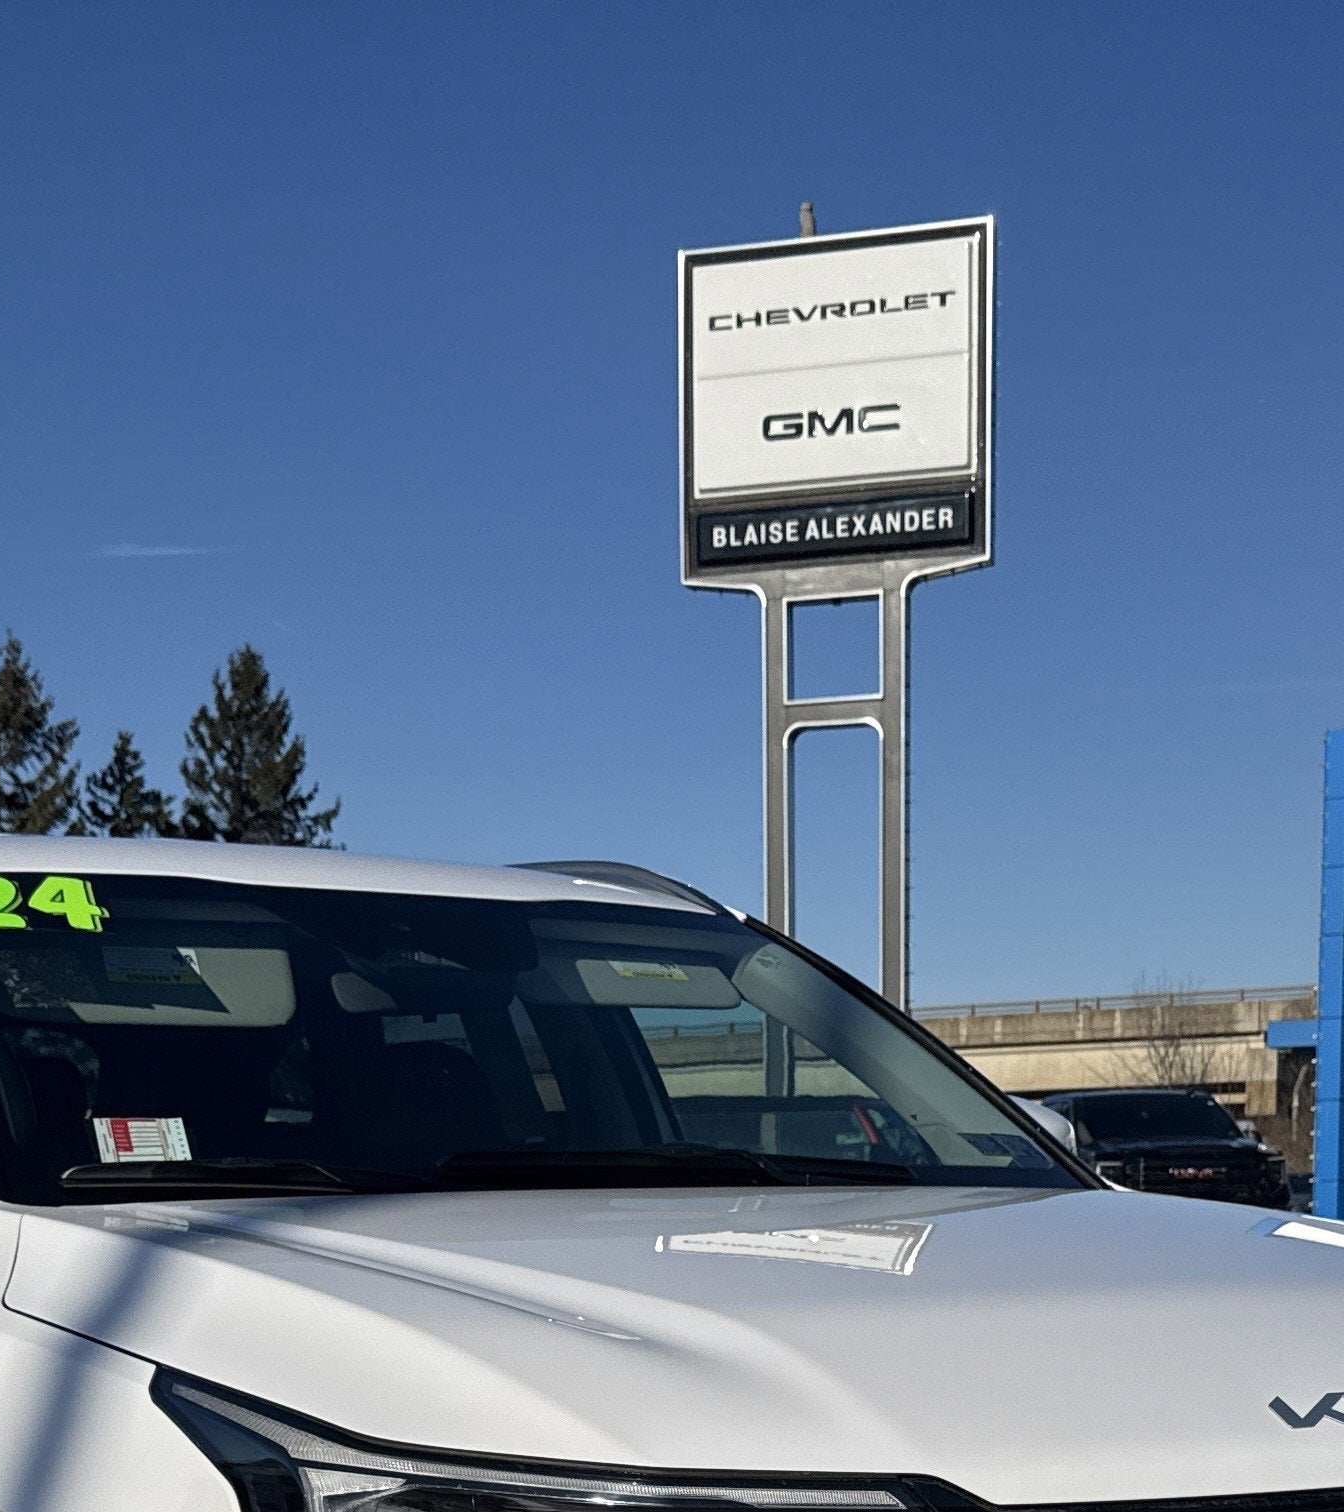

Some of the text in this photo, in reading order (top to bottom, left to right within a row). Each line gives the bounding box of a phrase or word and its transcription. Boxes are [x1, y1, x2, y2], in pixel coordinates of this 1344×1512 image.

[709, 290, 956, 332] CHEVROLET
[762, 402, 901, 442] GMC
[712, 506, 954, 550] BLAISE ALEXANDER
